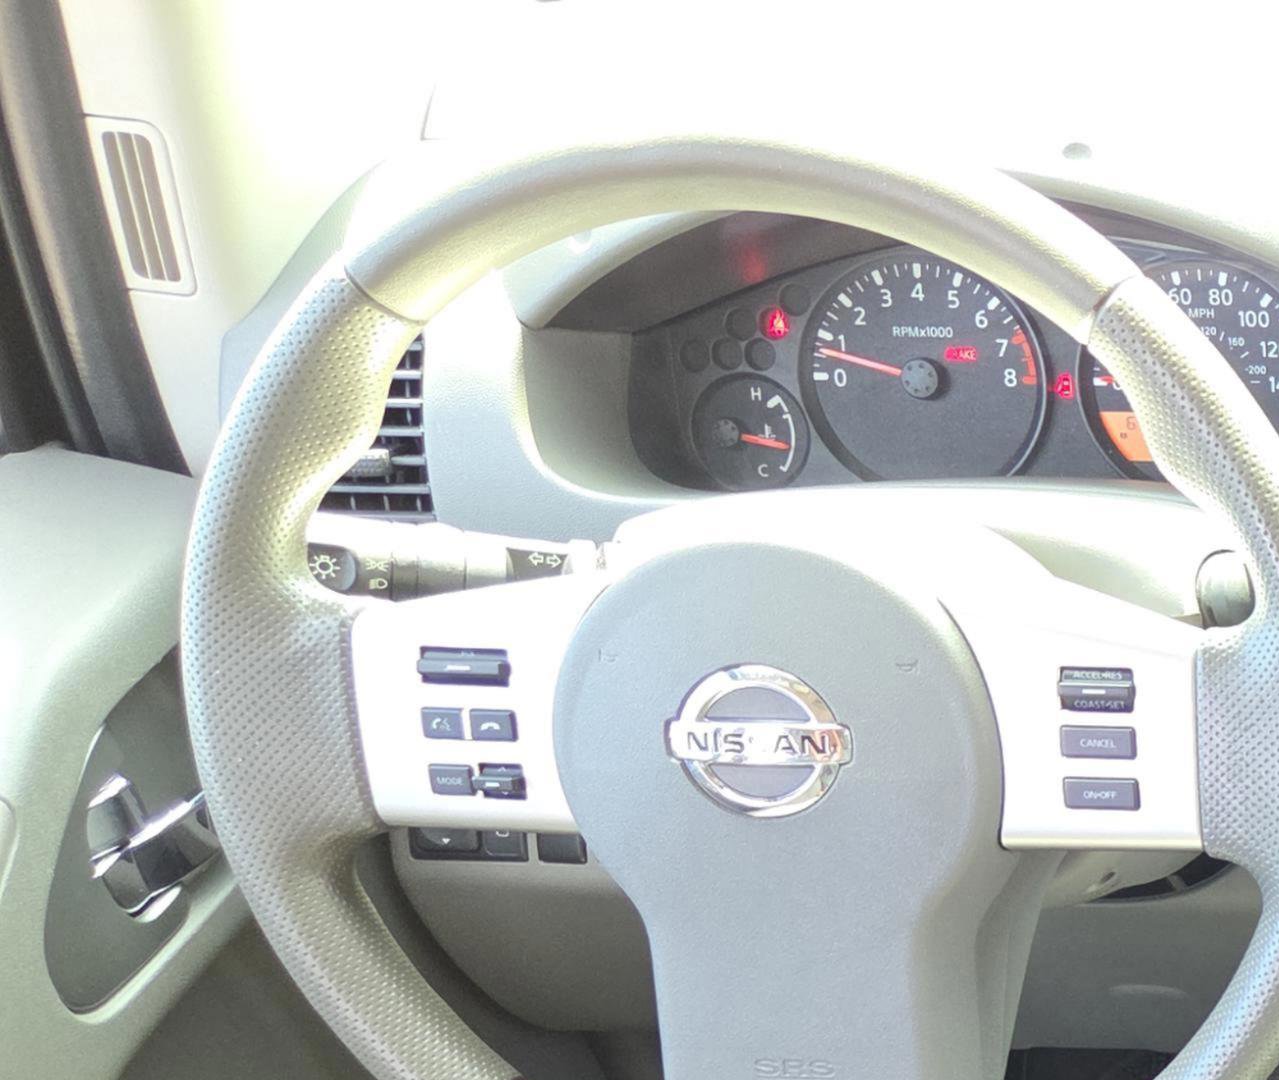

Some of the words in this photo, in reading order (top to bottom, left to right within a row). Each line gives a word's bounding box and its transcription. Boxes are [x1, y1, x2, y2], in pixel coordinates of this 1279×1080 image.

[881, 289, 892, 307] 3
[910, 283, 925, 301] 4
[948, 290, 960, 308] 5
[1168, 288, 1192, 305] 60
[1208, 289, 1233, 306] 80
[854, 307, 867, 325] 2
[975, 310, 988, 328] 6
[1188, 308, 1215, 319] MPH
[1238, 310, 1270, 328] 100
[893, 326, 954, 338] RPMx1000
[838, 335, 846, 352] 1
[995, 338, 1009, 357] 7
[834, 369, 847, 387] 0
[1004, 369, 1018, 387] 8
[750, 387, 762, 401] H
[757, 464, 769, 477] C
[1079, 737, 1116, 749] CANCEL
